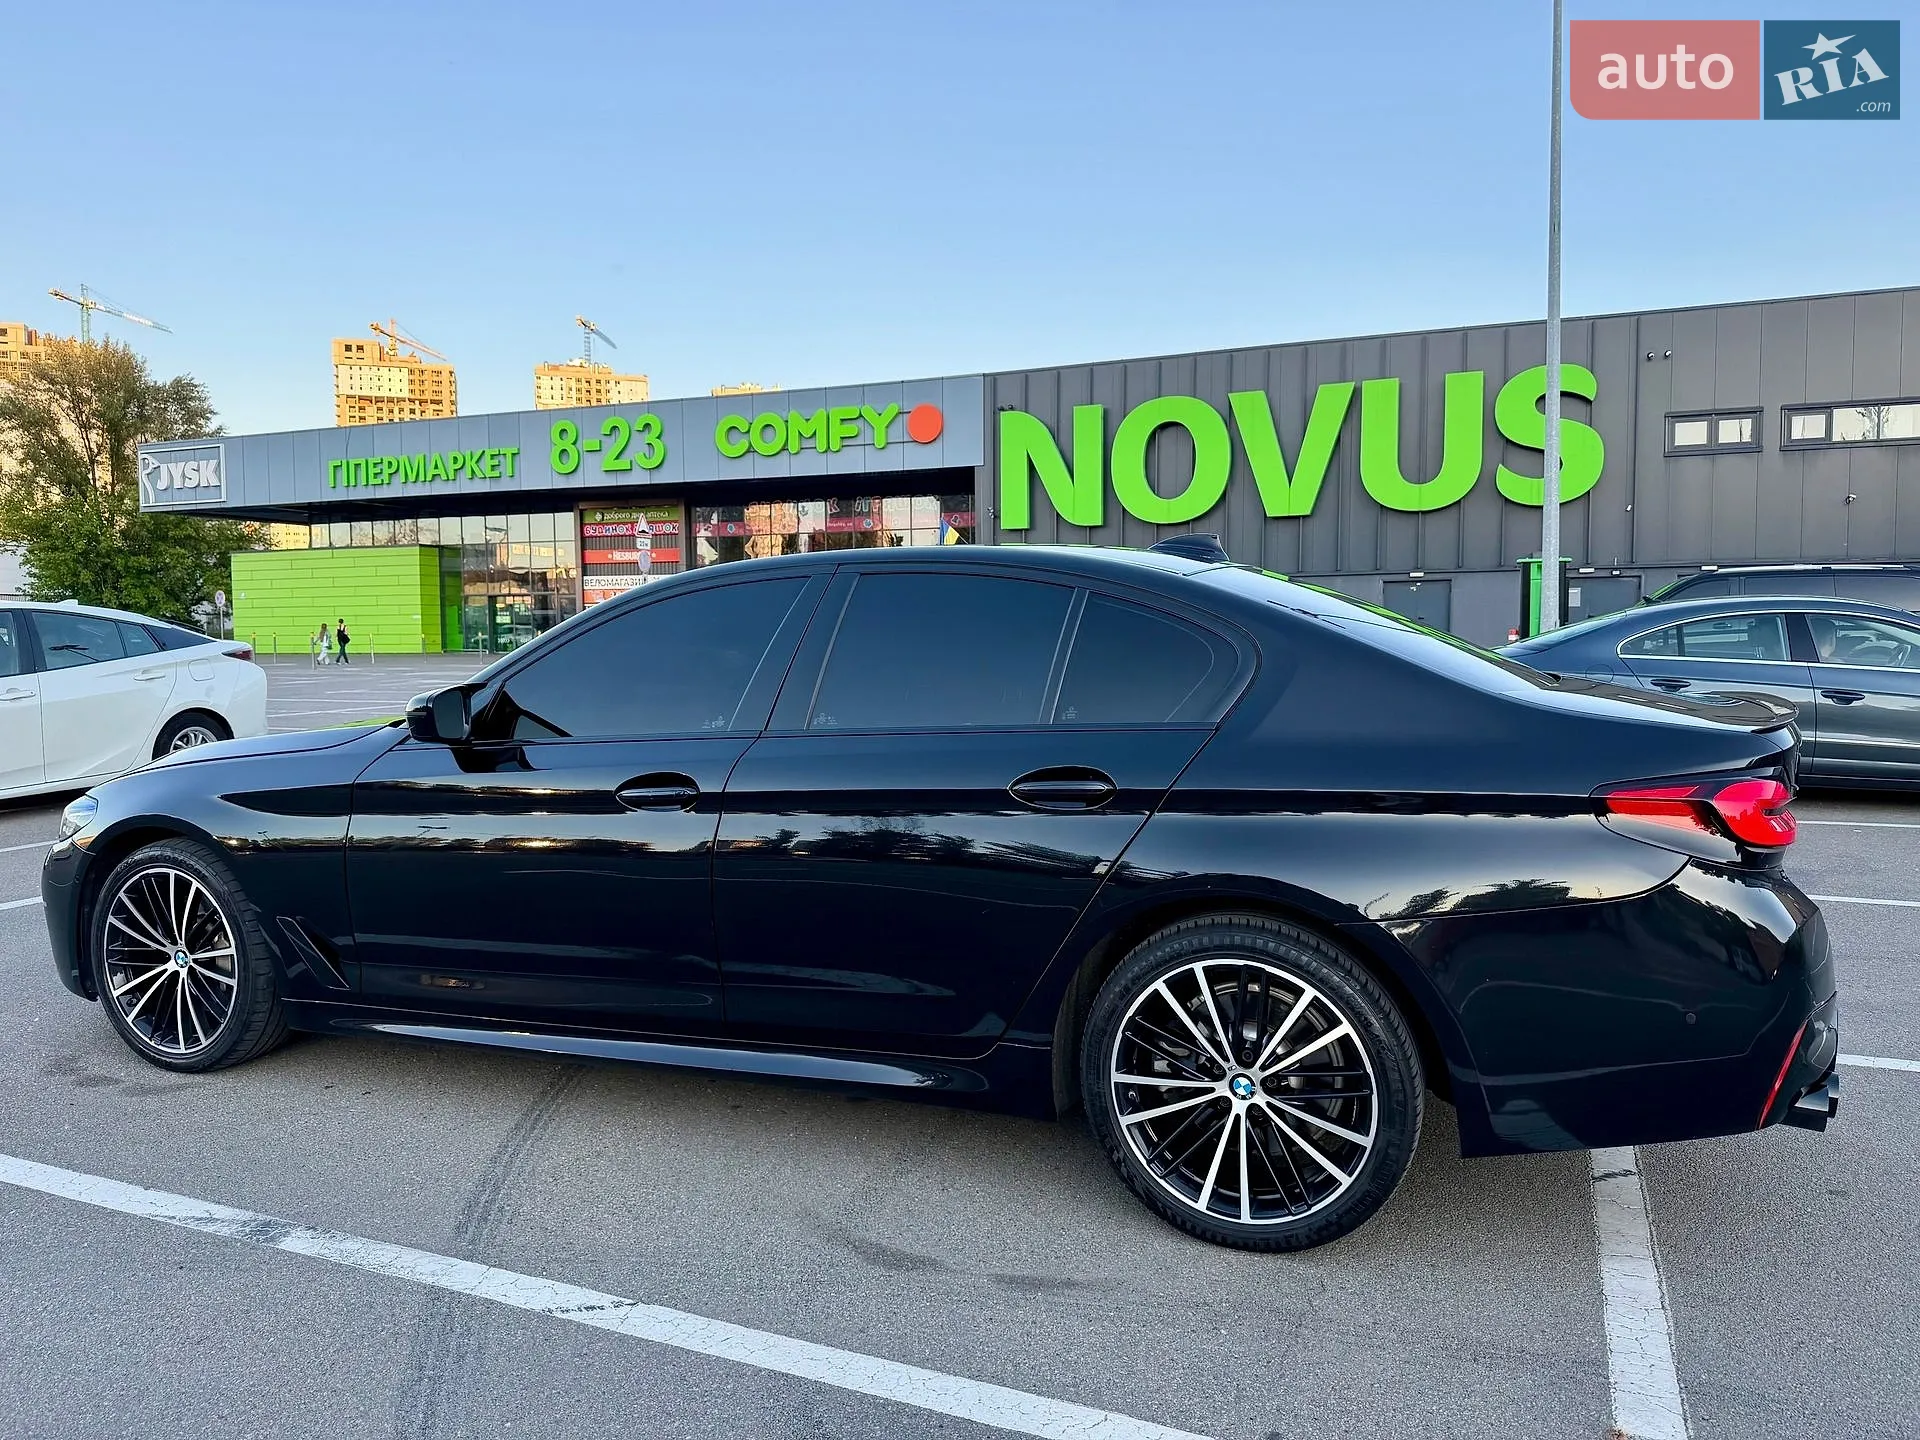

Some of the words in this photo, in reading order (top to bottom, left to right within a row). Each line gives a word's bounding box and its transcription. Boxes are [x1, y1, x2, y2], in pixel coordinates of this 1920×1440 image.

[327, 447, 519, 488] ГІПЕРМАРКЕТ
[550, 413, 666, 475] 8-23
[714, 402, 900, 458] COMFY
[999, 363, 1605, 530] NOVUS
[157, 459, 221, 491] JYSK
[584, 577, 647, 587] ВЕЛОМАГАЗИ
